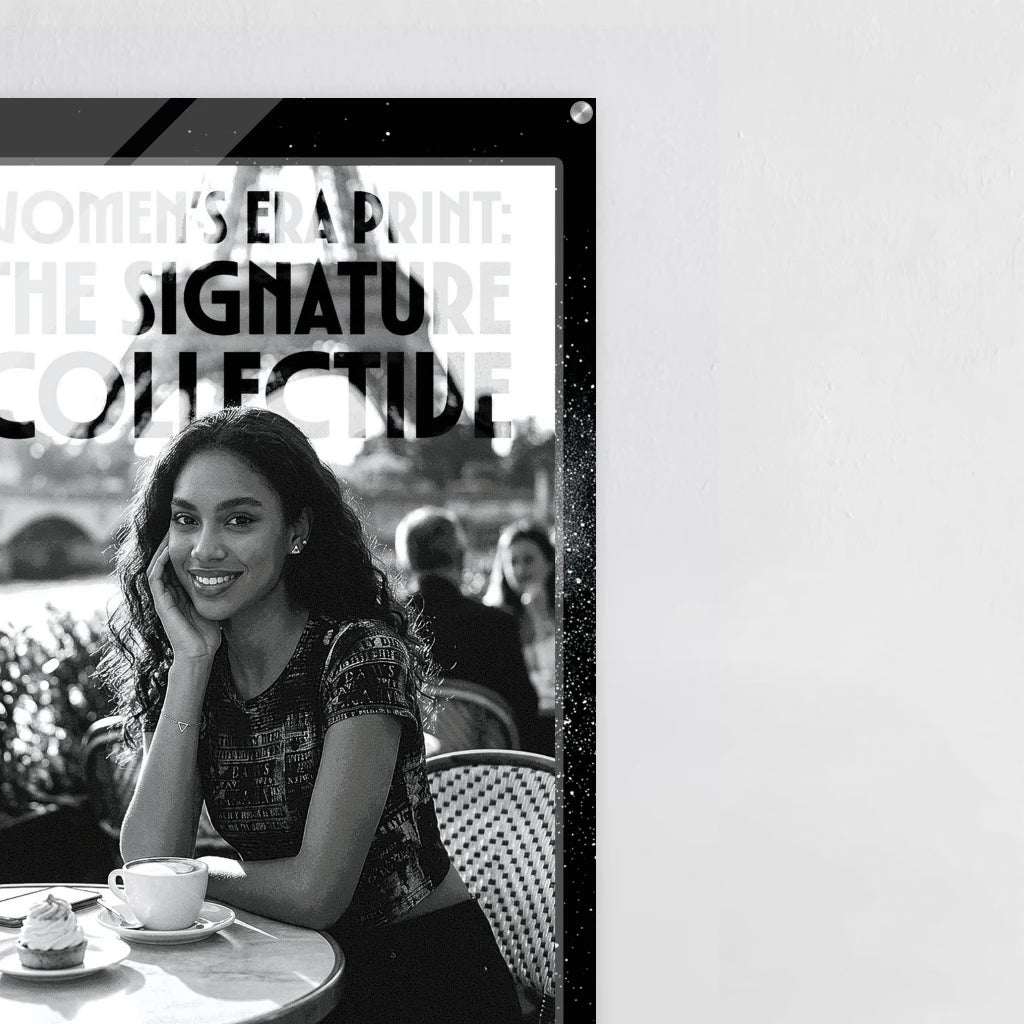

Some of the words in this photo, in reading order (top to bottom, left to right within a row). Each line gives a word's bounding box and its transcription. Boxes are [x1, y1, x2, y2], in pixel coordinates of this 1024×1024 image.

[246, 189, 338, 243] ERA
[353, 190, 511, 243] PRINT:
[122, 259, 511, 336] SIGNATURE
